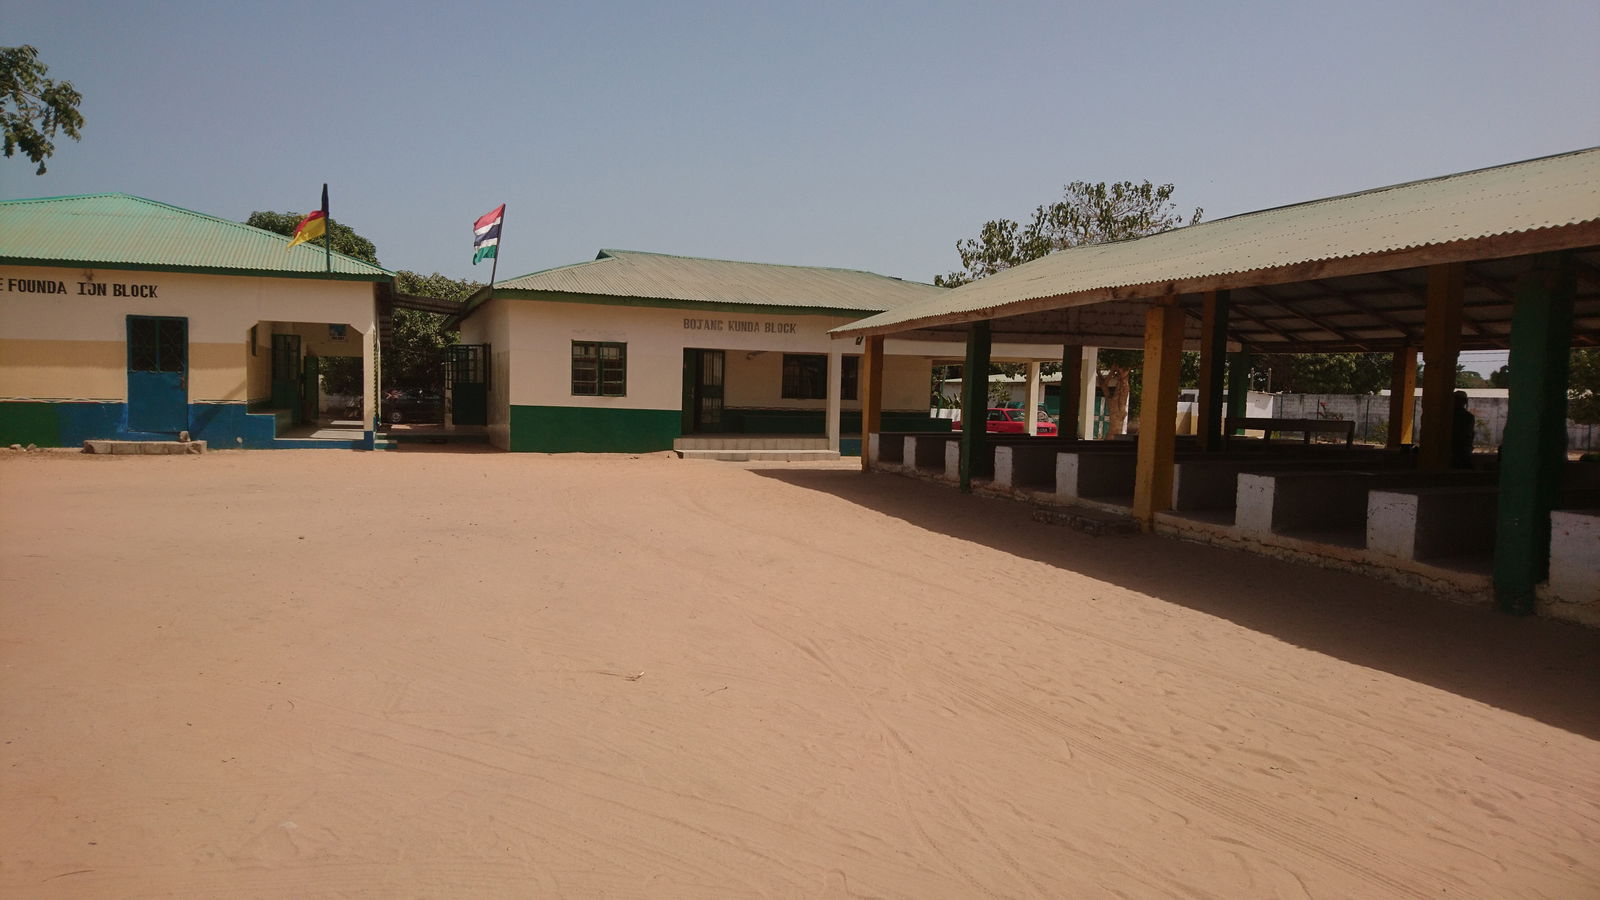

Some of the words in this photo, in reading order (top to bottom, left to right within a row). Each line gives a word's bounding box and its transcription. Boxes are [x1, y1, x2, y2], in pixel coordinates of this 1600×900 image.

[8, 278, 68, 295] FOUNDA
[112, 283, 158, 298] BLOCK
[728, 320, 760, 333] KUNDA
[764, 322, 796, 334] BLOCK
